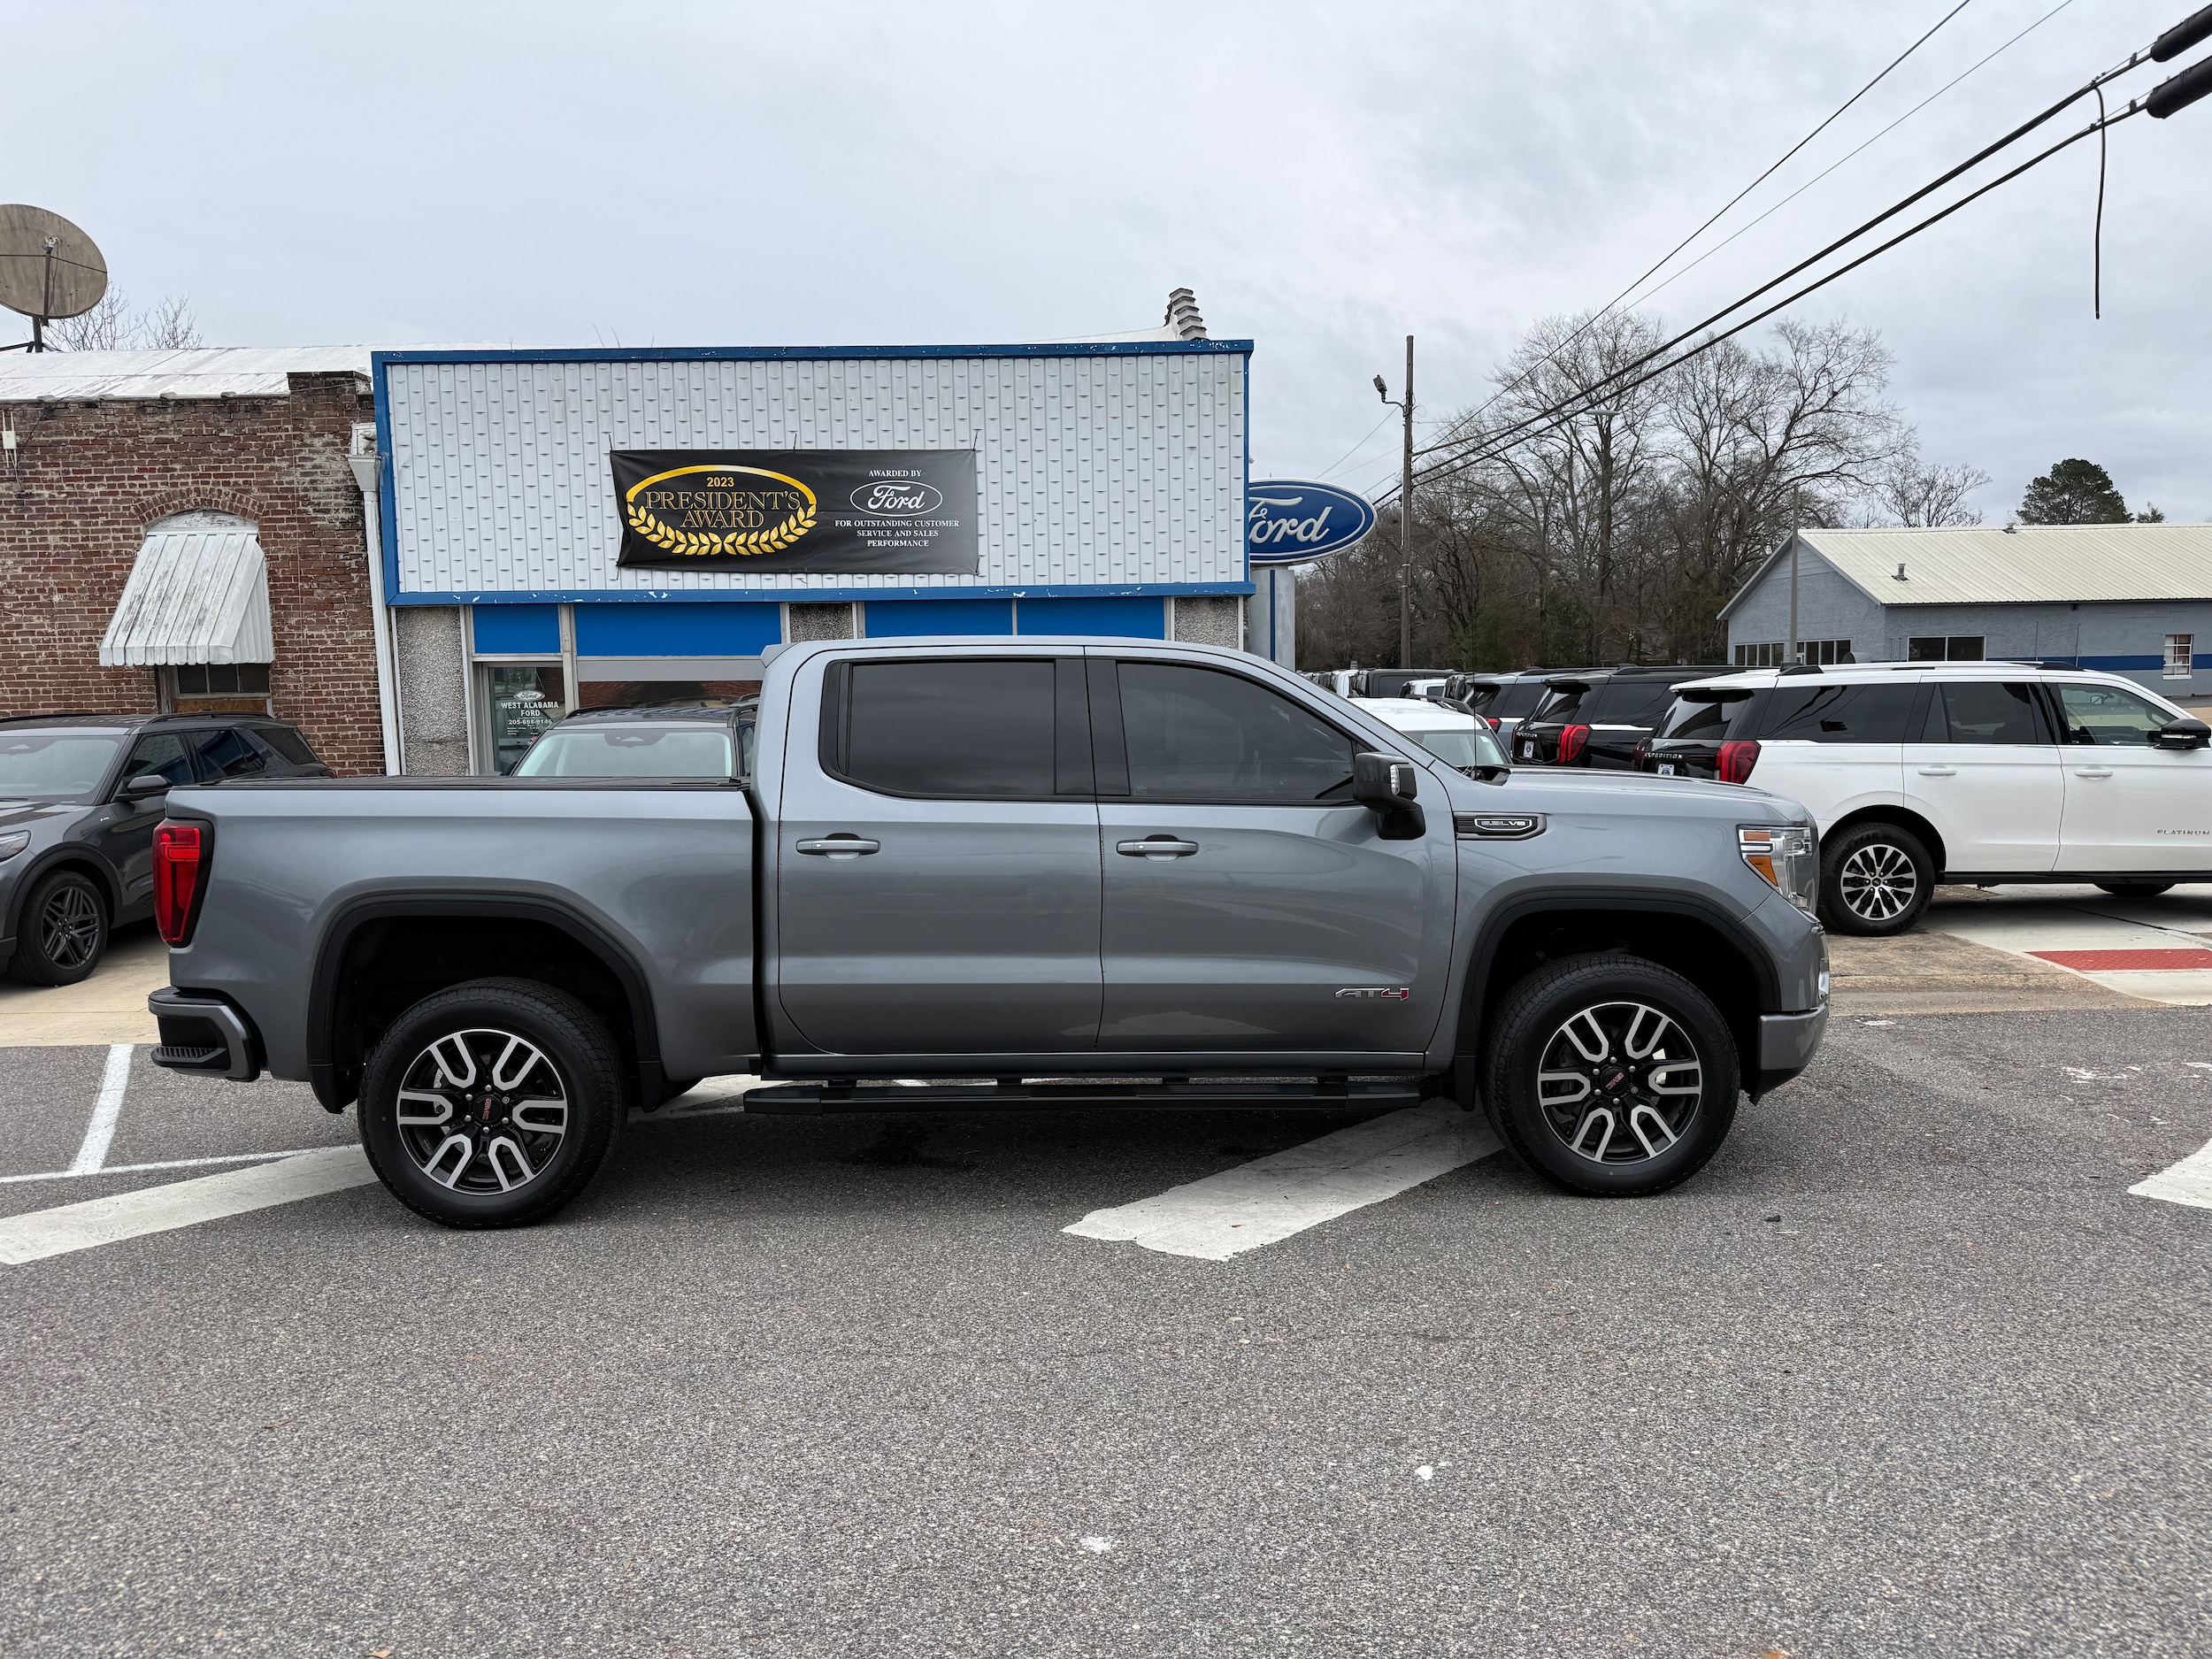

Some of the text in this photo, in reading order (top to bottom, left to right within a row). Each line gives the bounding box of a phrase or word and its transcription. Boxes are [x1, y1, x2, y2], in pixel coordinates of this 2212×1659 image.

[707, 477, 734, 487] 2023
[645, 491, 800, 511] PRESIDENT'S
[867, 485, 926, 510] Ford
[680, 510, 764, 528] AWARD
[1335, 987, 1409, 1002] AT4
